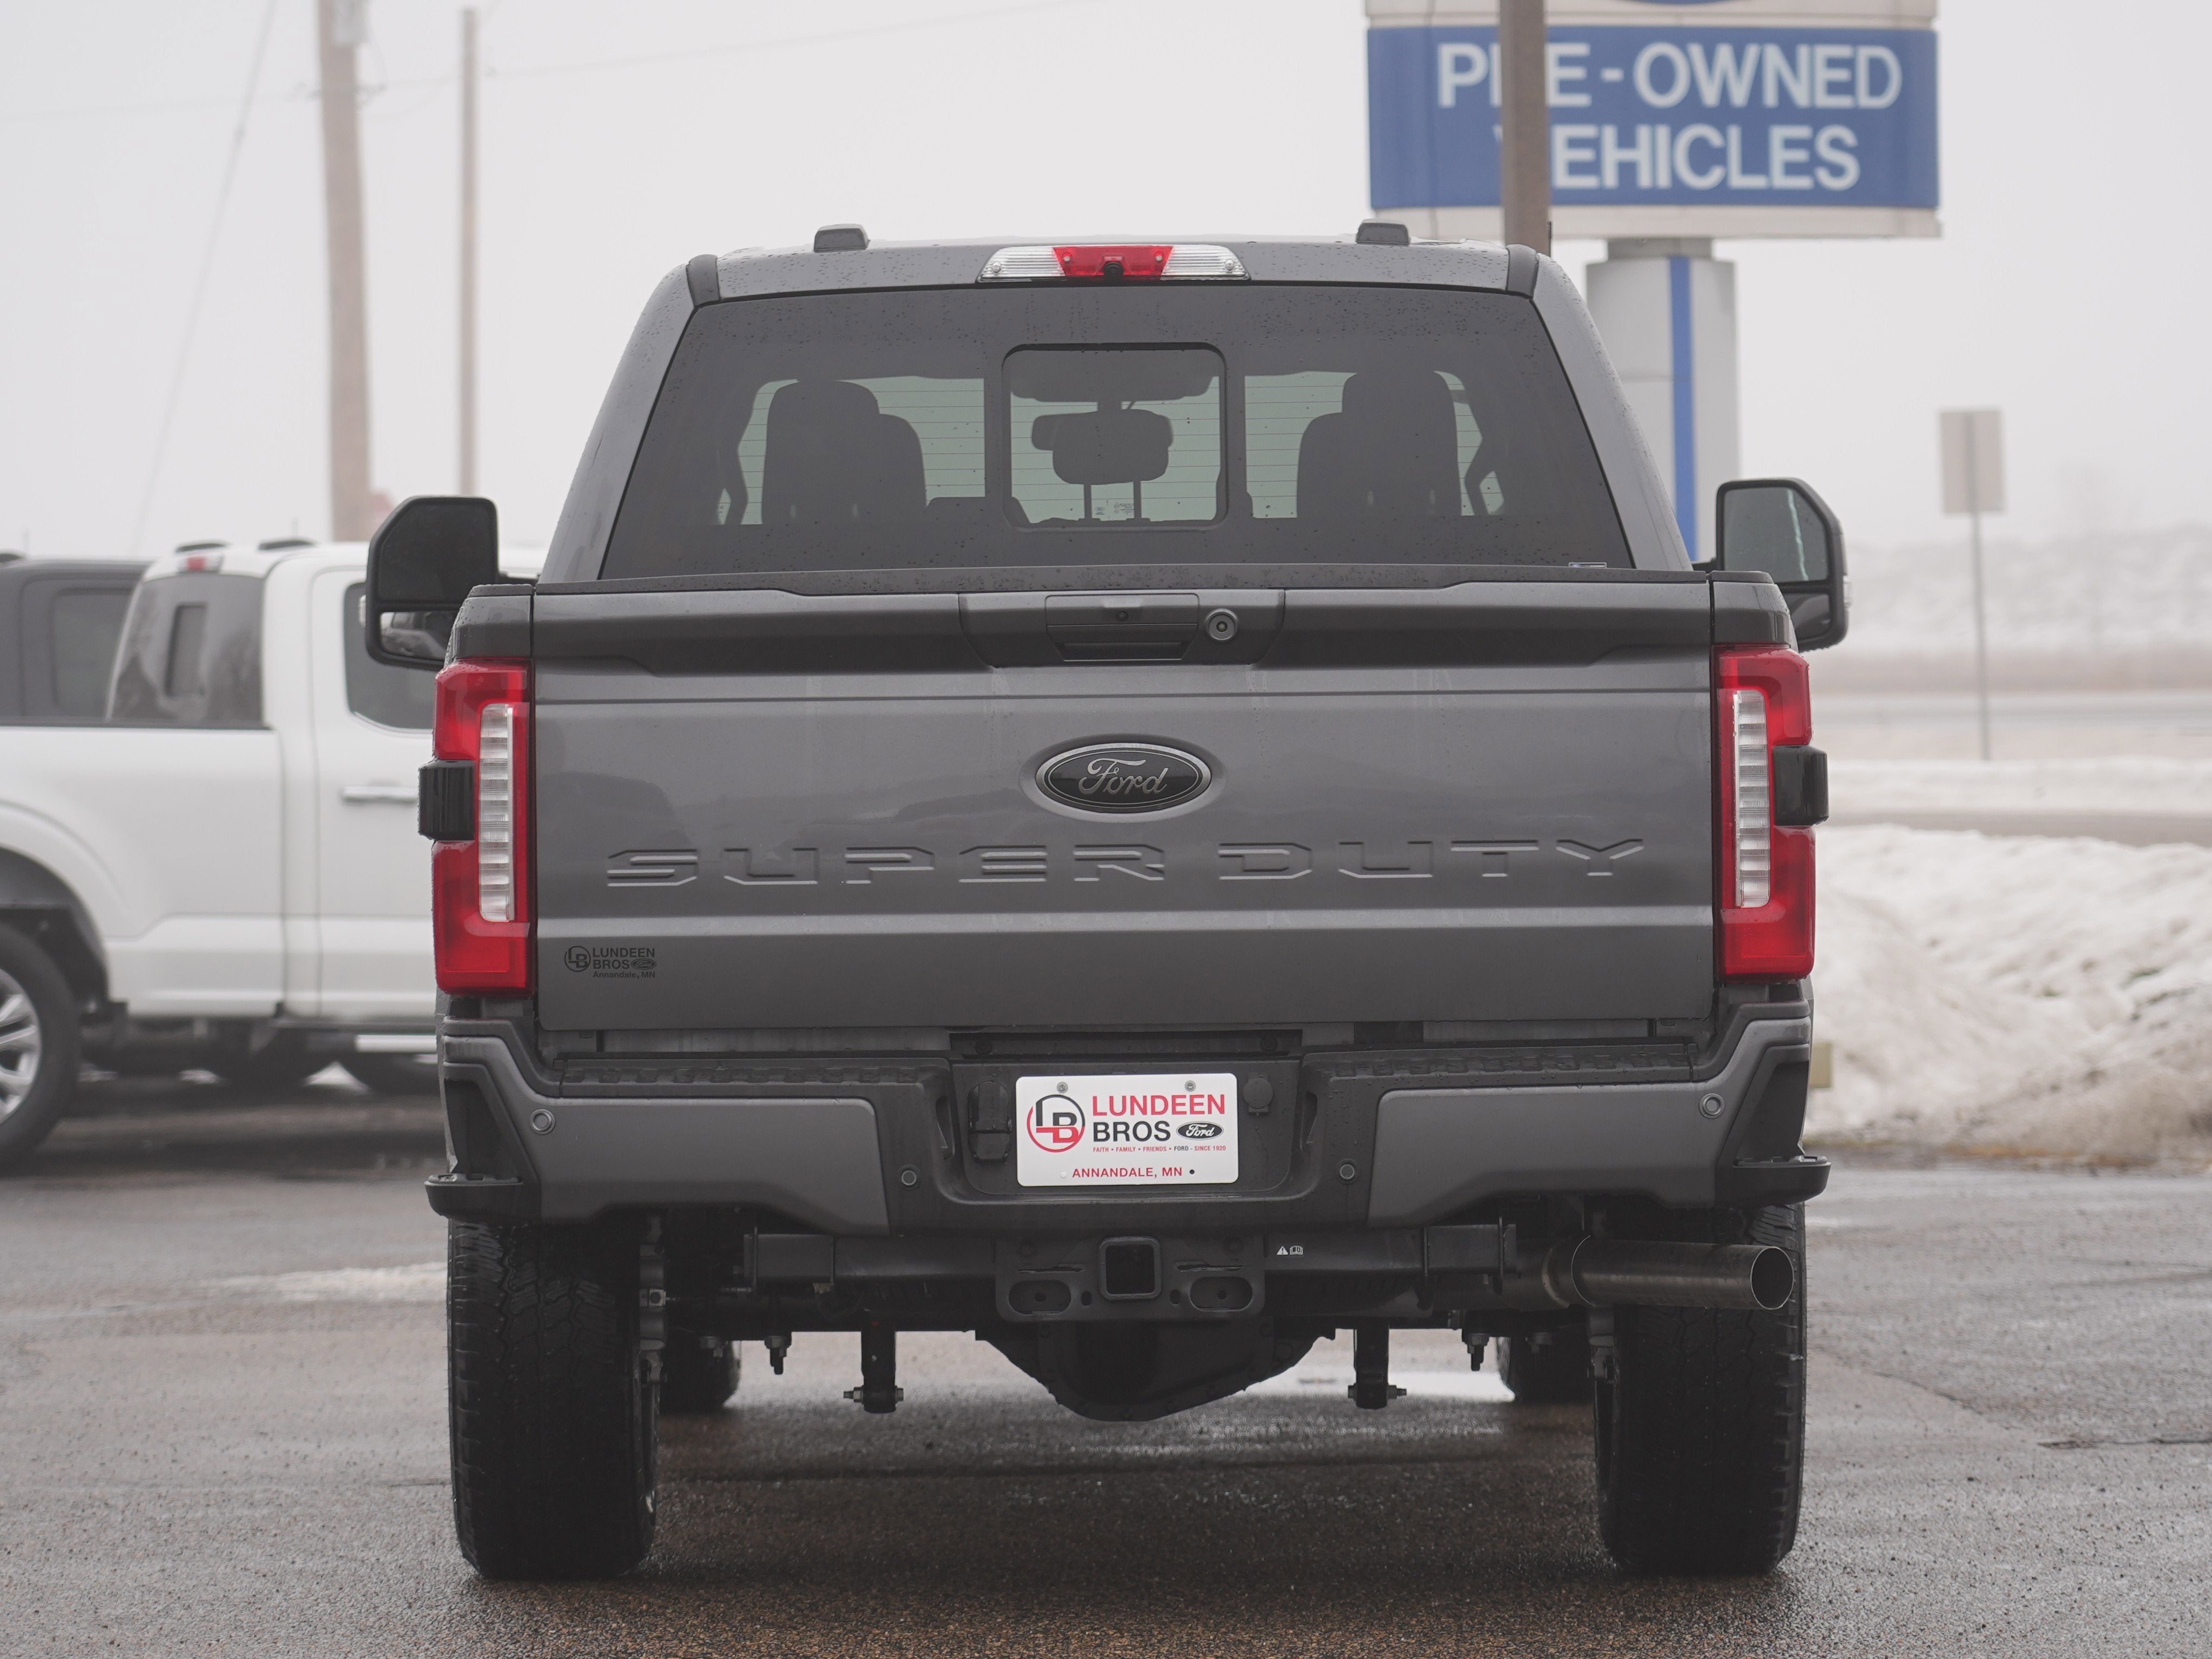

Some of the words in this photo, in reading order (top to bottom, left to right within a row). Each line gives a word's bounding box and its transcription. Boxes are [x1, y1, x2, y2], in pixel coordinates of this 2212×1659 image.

[1492, 124, 1861, 190] EHICLES
[1078, 757, 1169, 794] Ford
[607, 844, 1165, 887] SUPER
[1218, 839, 1644, 880] DUTY
[592, 947, 655, 958] LUNDEEN
[593, 959, 630, 969] BROS
[1092, 1094, 1226, 1116] LUNDEEN
[1092, 1121, 1171, 1143] BROS
[1185, 1123, 1216, 1138] Ford
[1072, 1167, 1157, 1179] ANNANDALE,
[1162, 1166, 1183, 1177] MN
